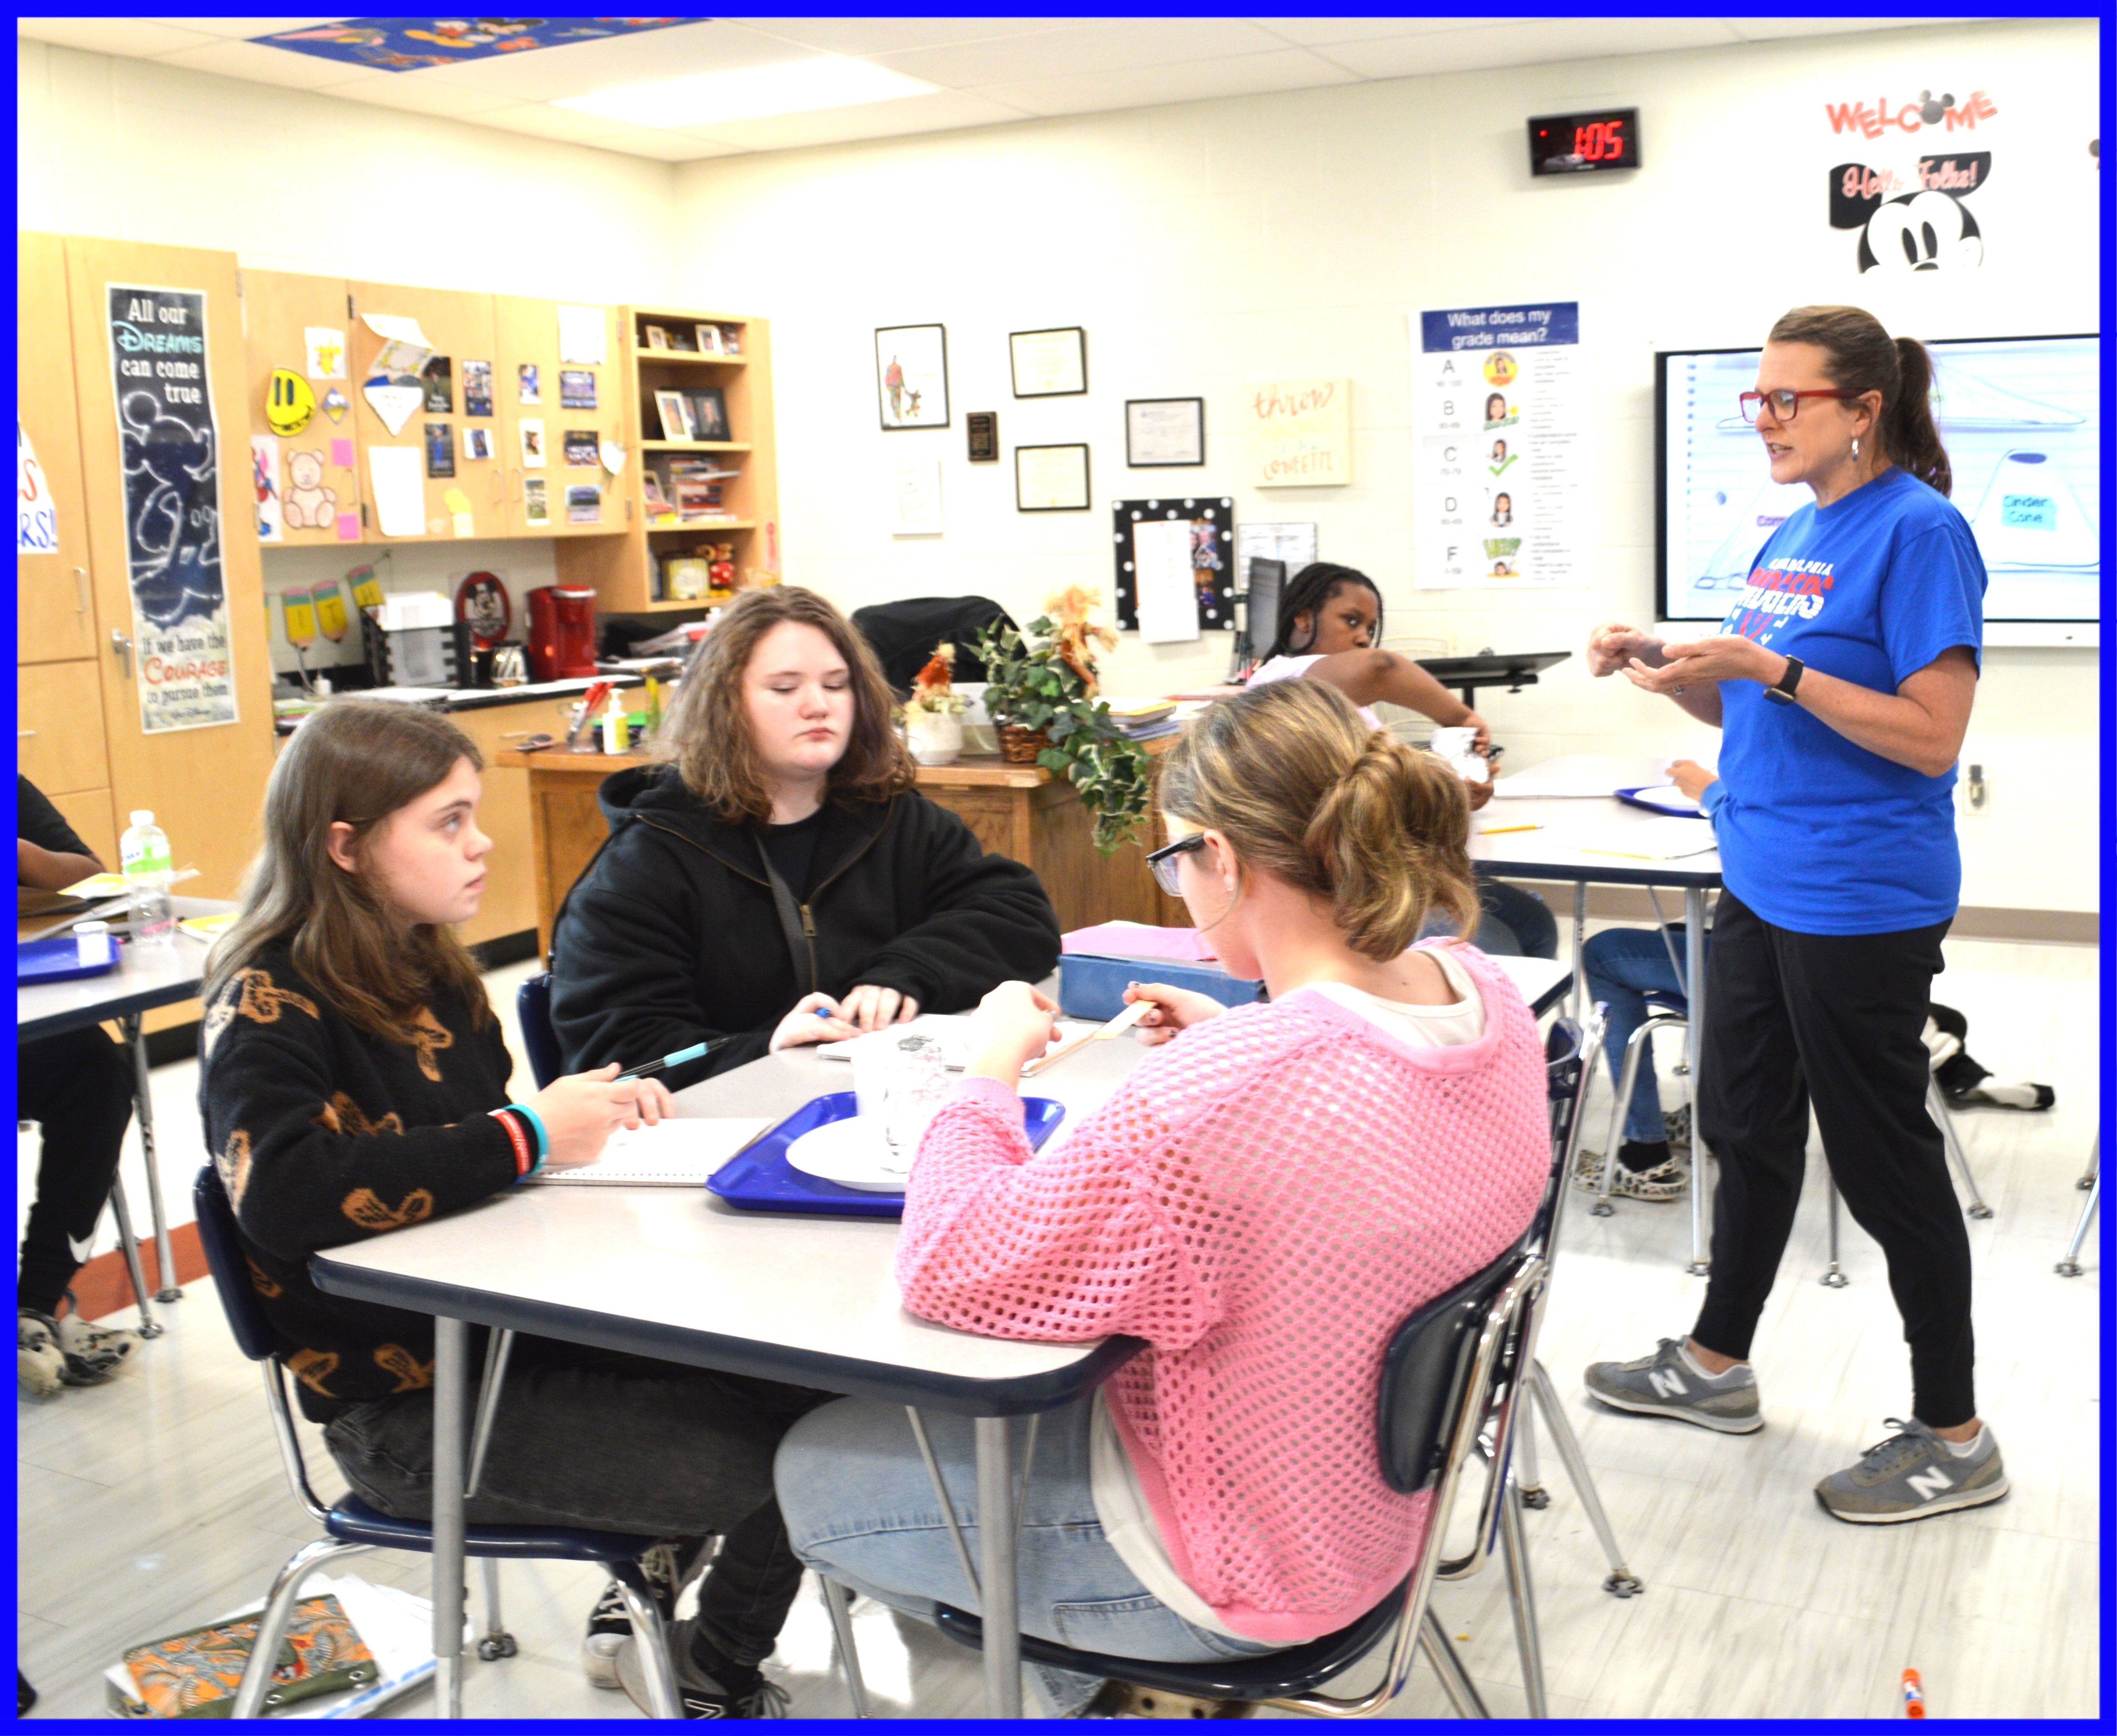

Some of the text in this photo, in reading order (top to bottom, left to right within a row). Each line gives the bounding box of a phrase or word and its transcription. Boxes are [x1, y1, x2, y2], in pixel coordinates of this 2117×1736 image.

[1825, 89, 1998, 140] WELCOME
[1573, 120, 1623, 161] 1:05
[1842, 159, 1979, 199] Hello Folks!
[128, 298, 188, 325] All our
[1447, 309, 1552, 328] What does my
[111, 320, 203, 354] DREAMS
[1451, 327, 1548, 350] grade mean?
[120, 358, 200, 379] can come
[1441, 358, 1457, 374] A
[163, 382, 202, 404] true
[1252, 382, 1335, 421] throw
[1444, 400, 1455, 415] B
[1443, 445, 1458, 462] C
[1445, 496, 1458, 512] D
[18, 508, 58, 548] RS!
[1447, 545, 1459, 562] F
[143, 656, 228, 685] COURAGE
[1648, 1368, 1690, 1399] N
[1905, 1465, 1955, 1501] N
